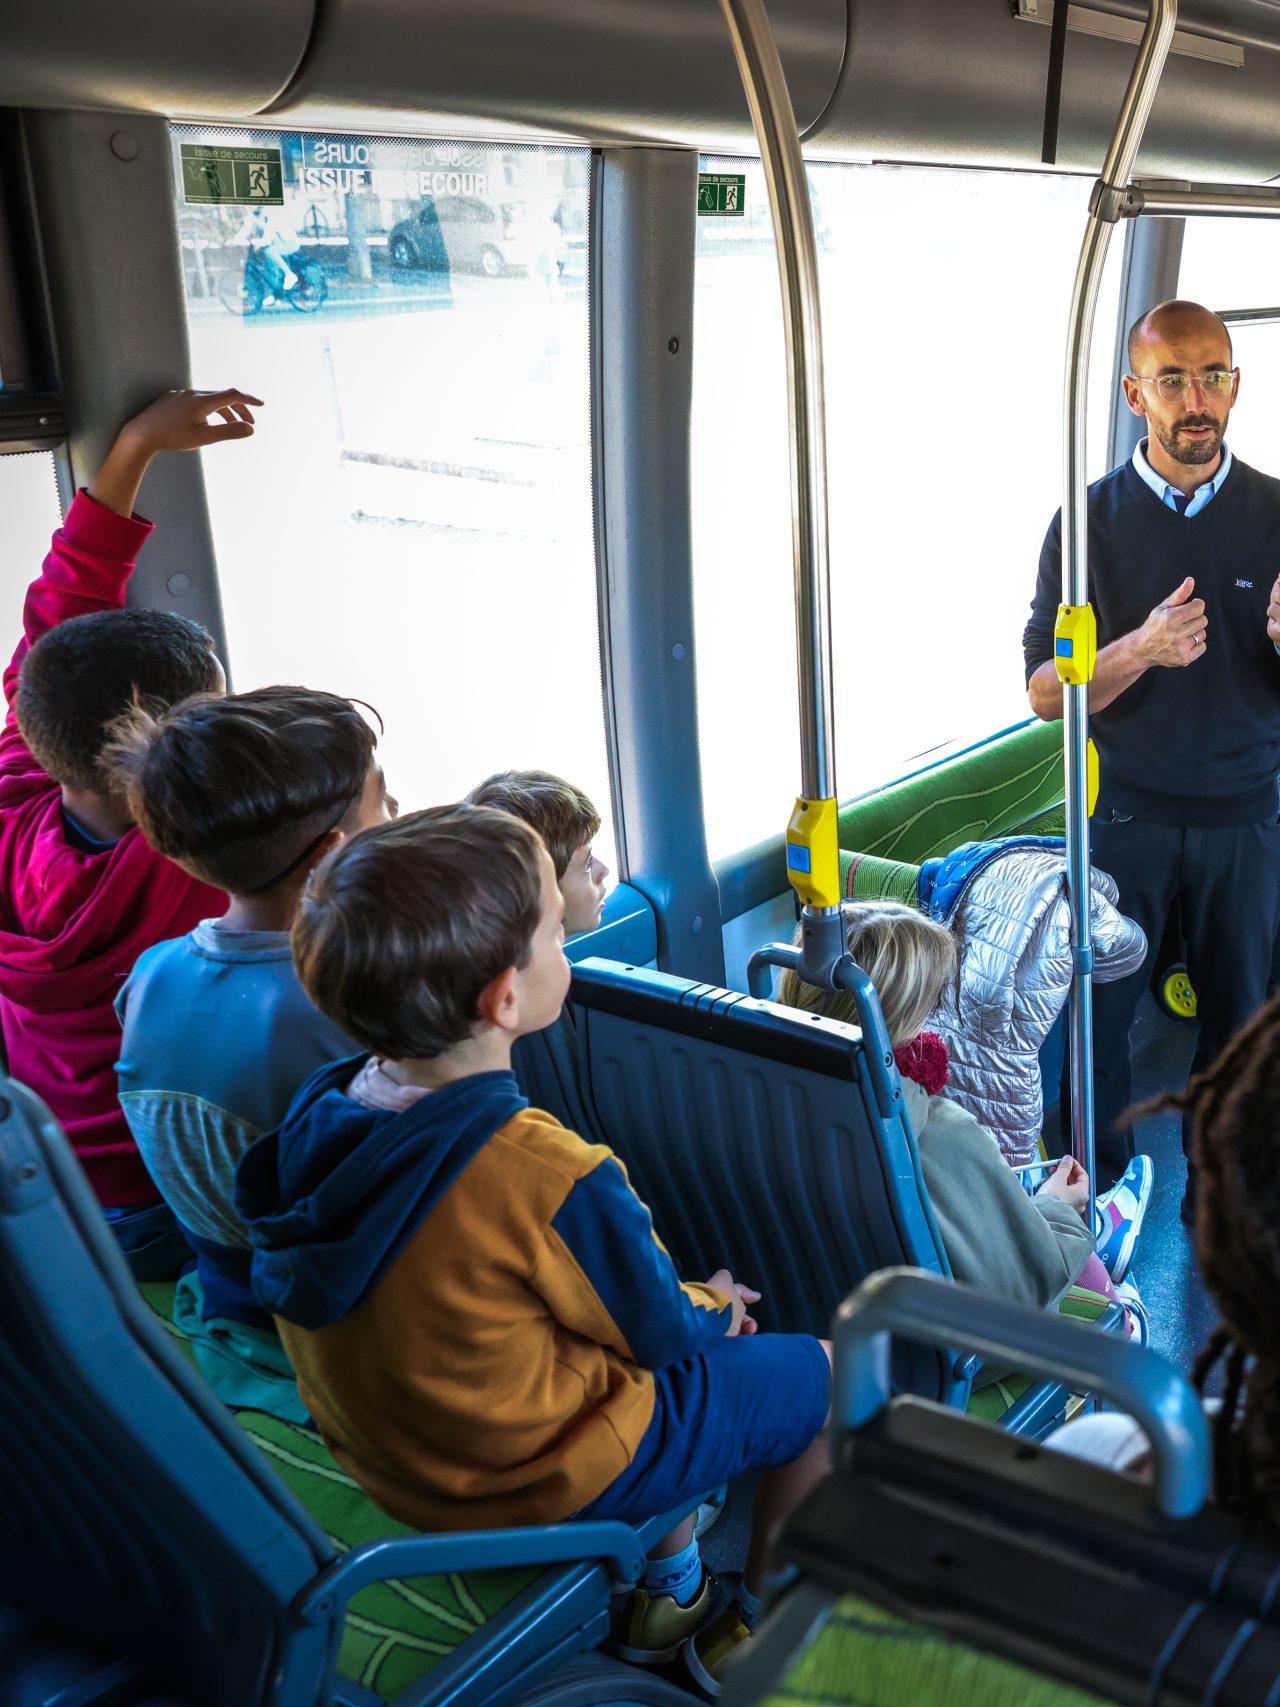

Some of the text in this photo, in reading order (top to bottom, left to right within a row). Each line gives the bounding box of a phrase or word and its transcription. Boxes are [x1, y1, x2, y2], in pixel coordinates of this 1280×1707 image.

[194, 147, 268, 160] Issue de secours
[299, 168, 366, 194] ISSUE
